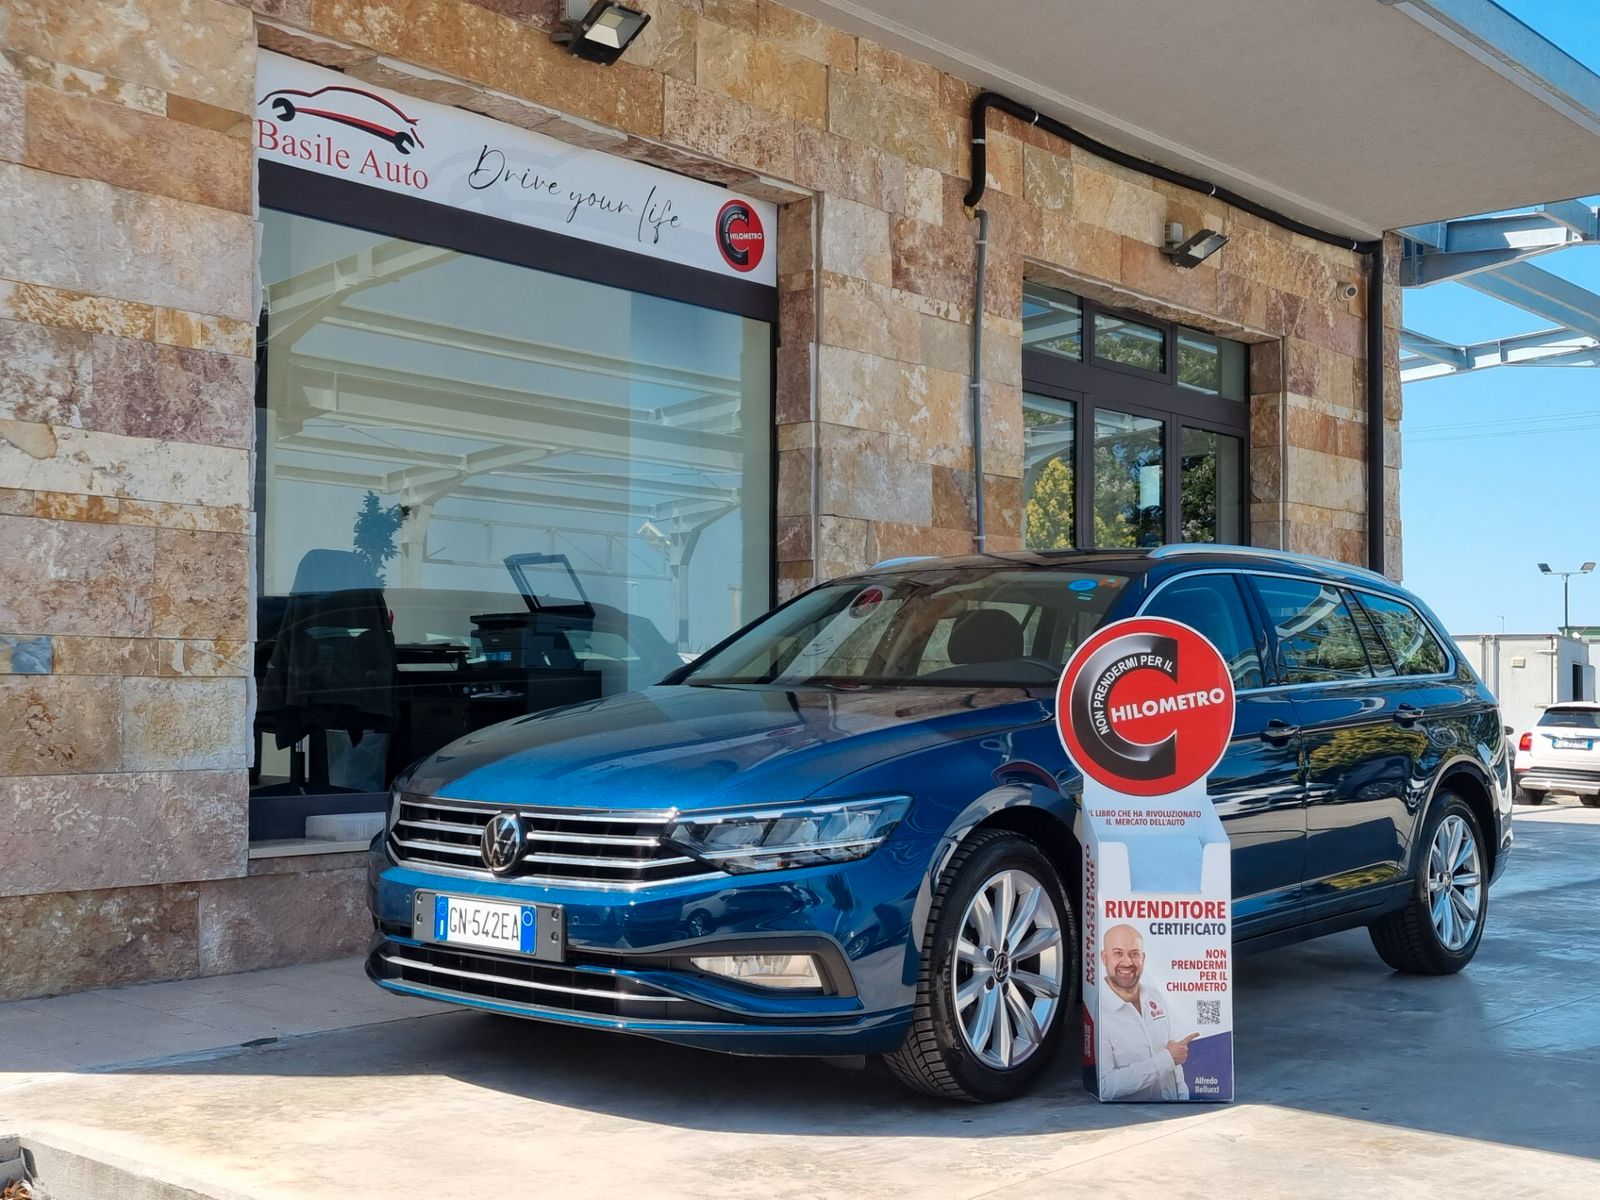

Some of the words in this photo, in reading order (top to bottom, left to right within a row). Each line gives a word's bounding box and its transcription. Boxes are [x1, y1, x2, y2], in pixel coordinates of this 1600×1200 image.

[257, 118, 350, 169] Basile
[359, 149, 429, 190] Auto
[467, 144, 561, 195] Drive
[566, 186, 634, 224] your
[637, 185, 683, 244] life
[1140, 655, 1162, 668] PER
[1164, 660, 1174, 673] IL
[1094, 657, 1139, 708] PRENDERMI
[1093, 710, 1110, 736] NON
[1146, 810, 1202, 818] RIVOLUZIONATO
[1105, 900, 1227, 919] RIVENDITORE
[450, 907, 467, 935] GN
[472, 909, 520, 942] 542EA
[1149, 922, 1227, 935] CERTIFICATO
[1205, 949, 1227, 959] NON
[1171, 960, 1227, 970] PRENDERMI
[1200, 971, 1218, 981] PER
[1219, 971, 1228, 981] IL
[1166, 982, 1228, 992] CHILOMETRO
[1195, 1077, 1218, 1085] Alfredo
[1195, 1086, 1220, 1094] Bellucci
